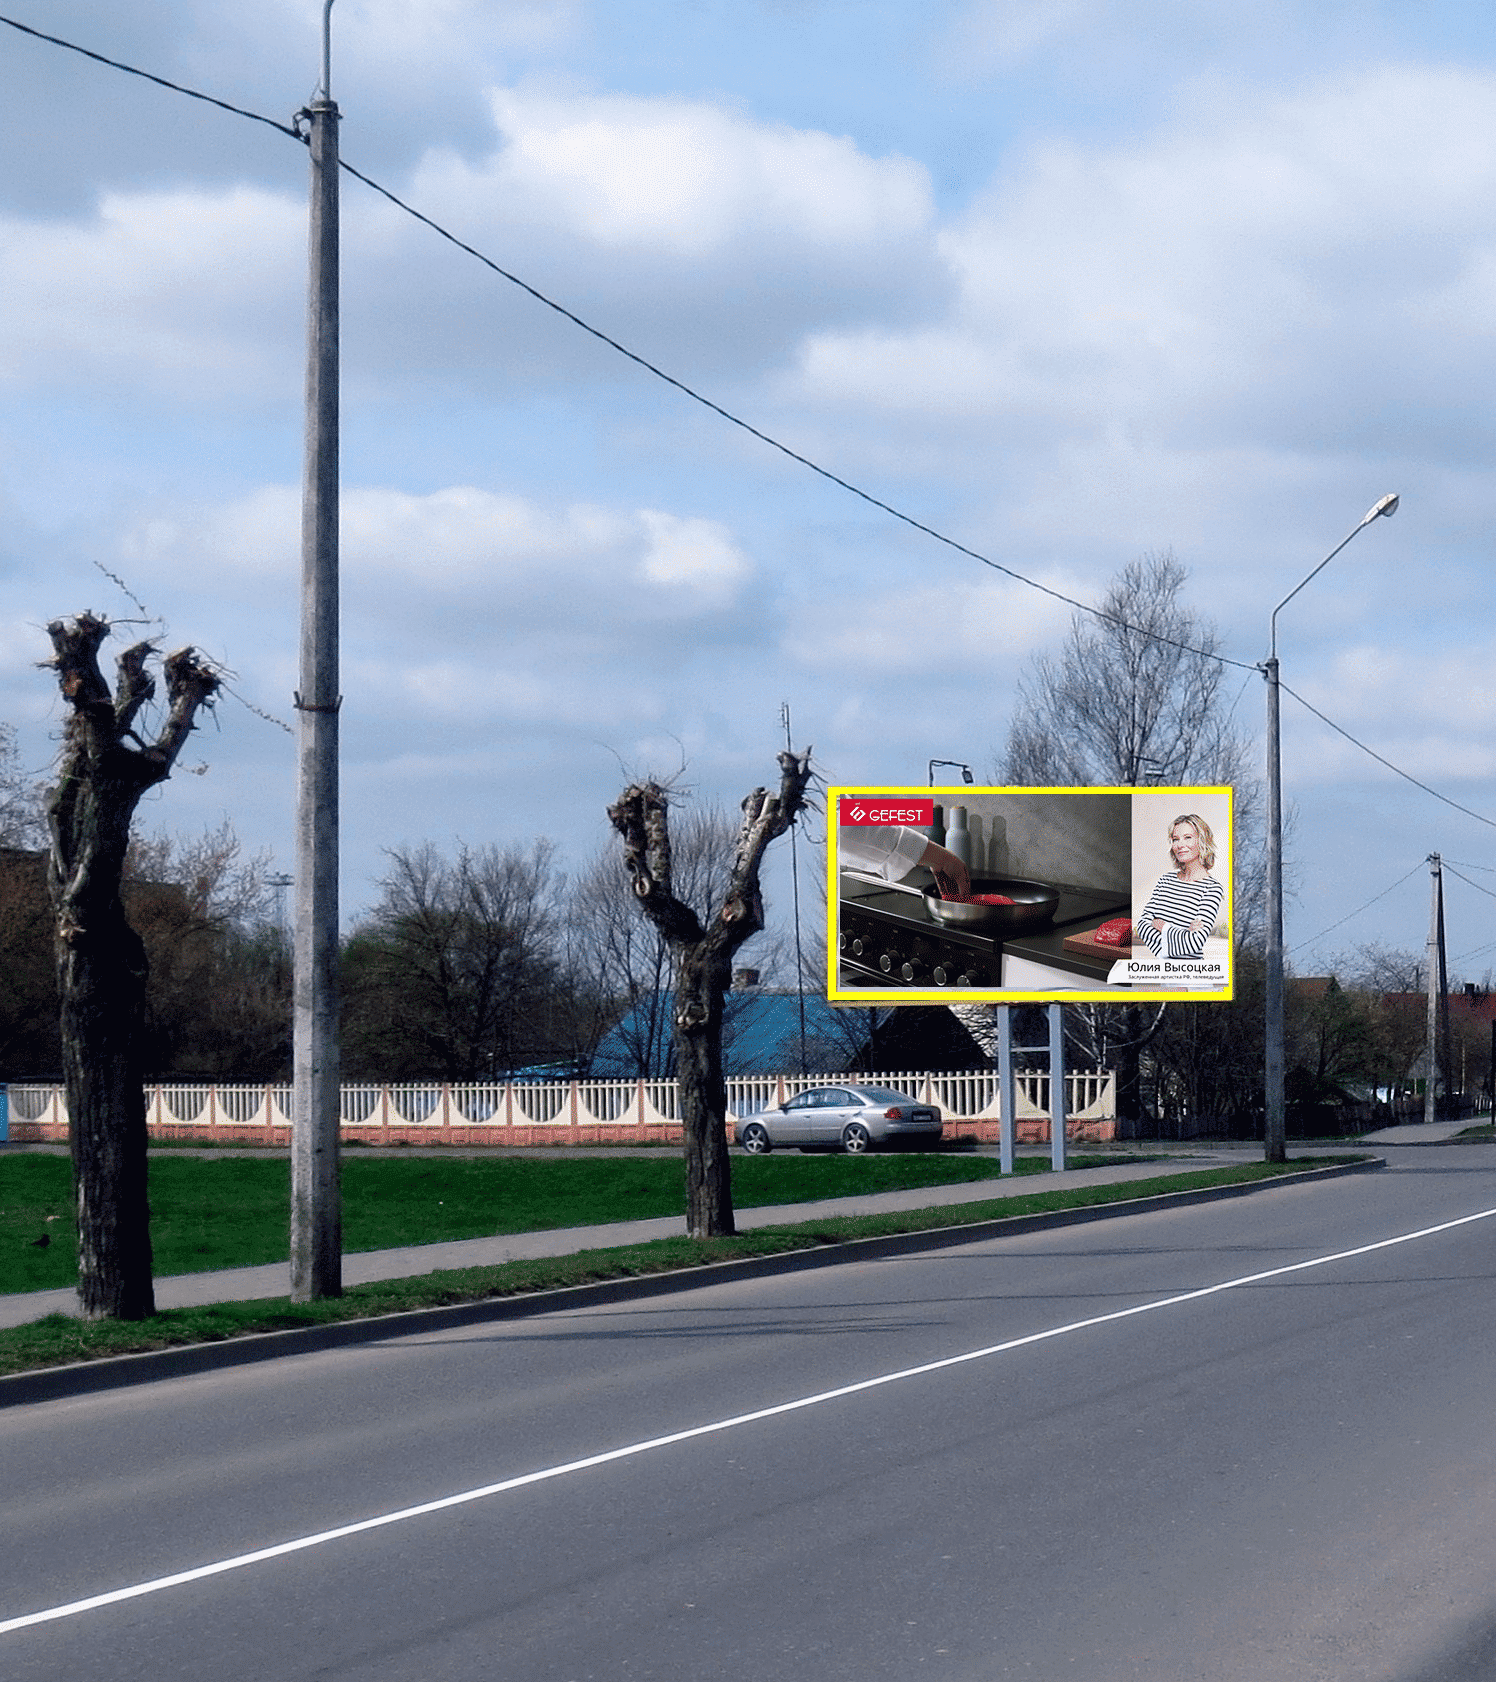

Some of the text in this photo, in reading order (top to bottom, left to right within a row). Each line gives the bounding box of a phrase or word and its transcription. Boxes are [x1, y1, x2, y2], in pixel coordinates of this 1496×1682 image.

[869, 810, 923, 822] GEFEST
[1128, 962, 1221, 974] Юлия Высоцкая
